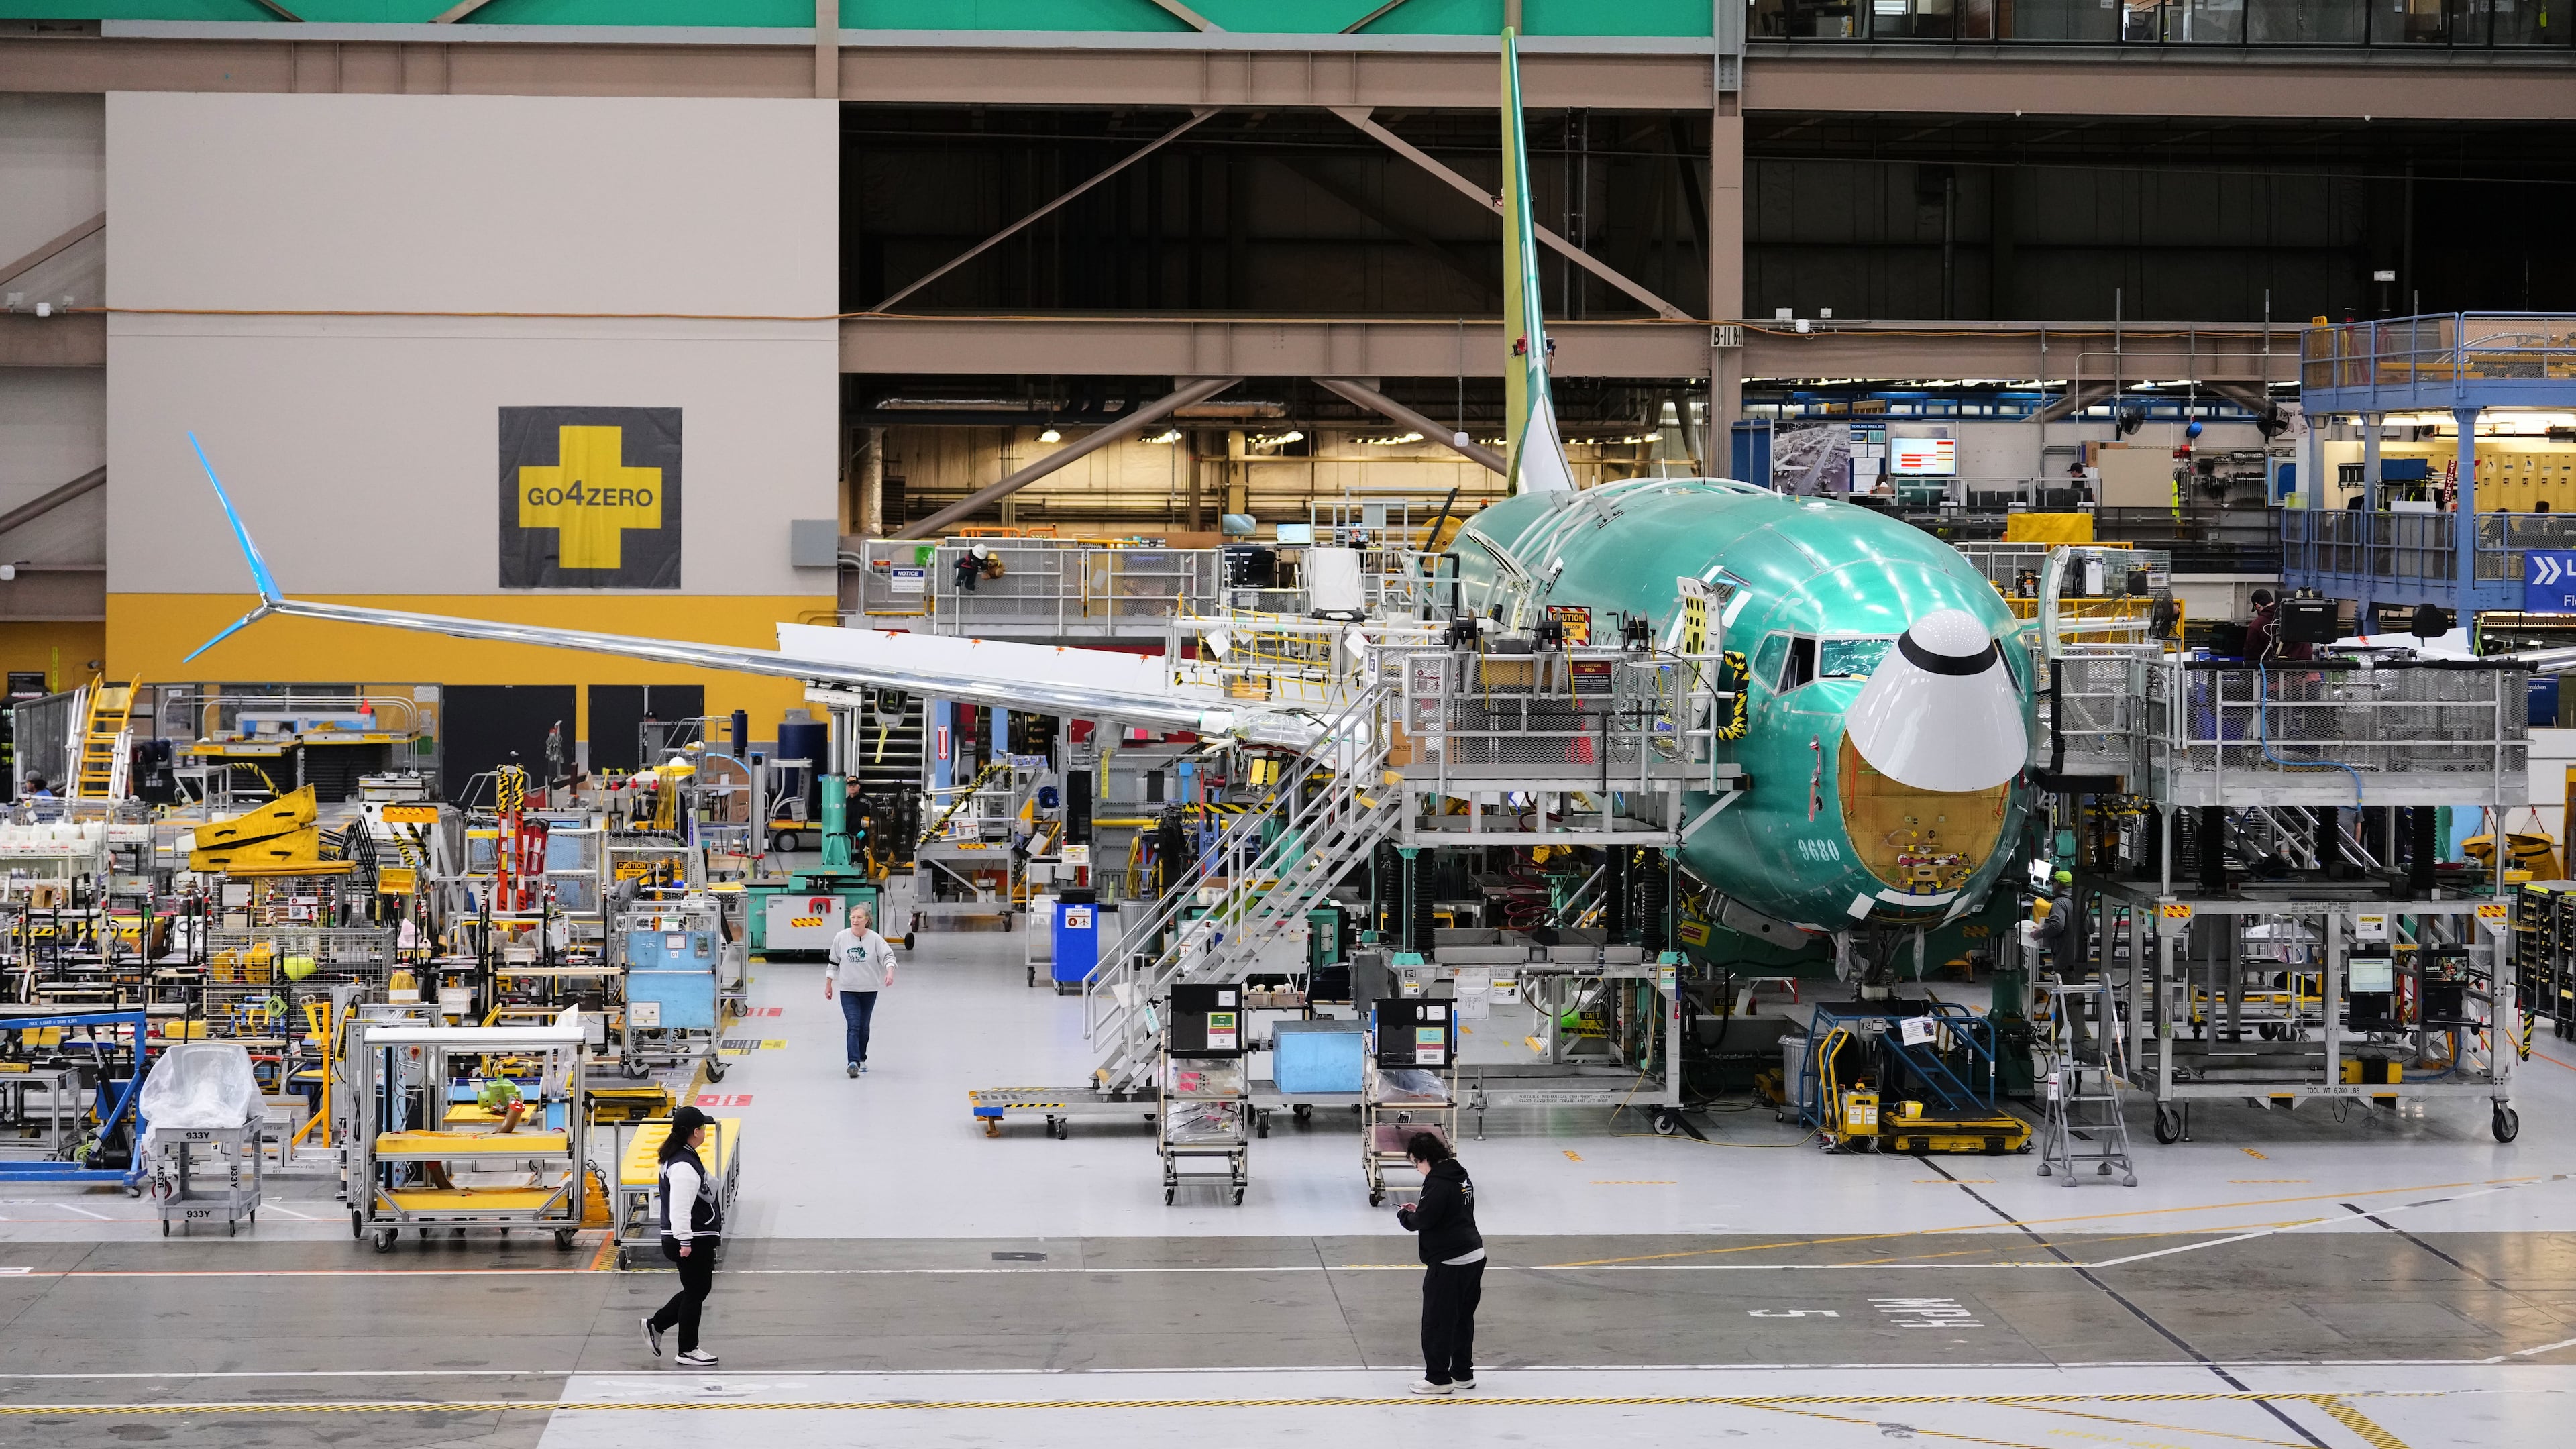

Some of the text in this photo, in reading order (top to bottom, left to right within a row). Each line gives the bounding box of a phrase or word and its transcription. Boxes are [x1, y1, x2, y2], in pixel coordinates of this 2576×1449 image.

[527, 480, 653, 507] GO4ZERO
[1553, 614, 1584, 622] CUTION
[1798, 839, 1840, 861] 9680
